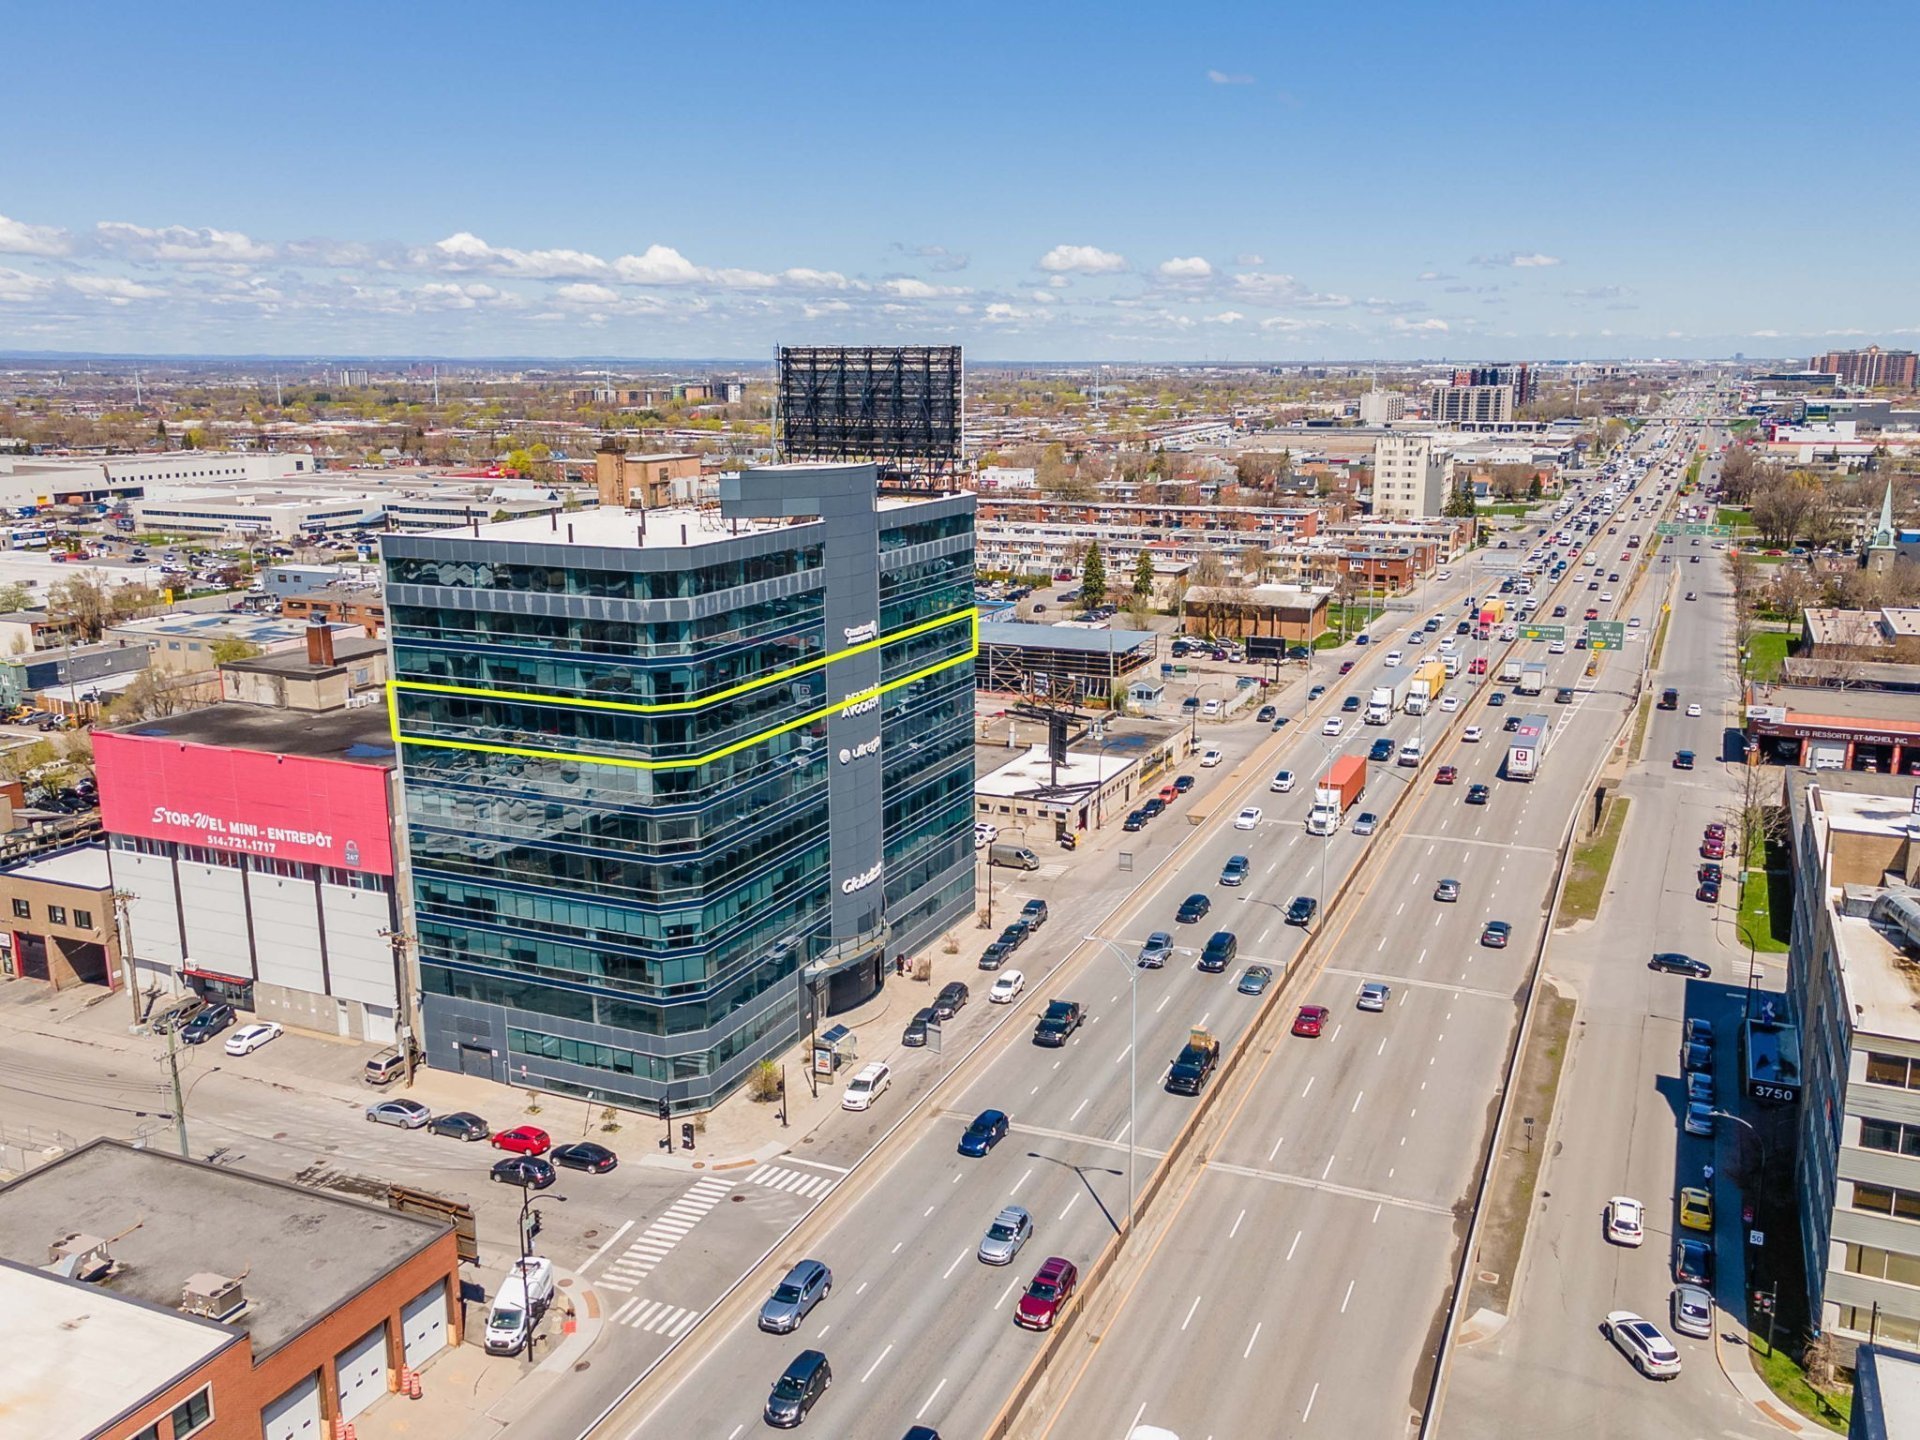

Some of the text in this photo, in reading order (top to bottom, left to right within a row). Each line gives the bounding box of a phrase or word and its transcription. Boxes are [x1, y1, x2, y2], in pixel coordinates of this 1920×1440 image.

[1795, 729, 1810, 737] LES
[1812, 731, 1851, 740] RESSORTS
[229, 821, 258, 837] MINI
[267, 827, 332, 848] ENTREPÔT
[207, 834, 276, 854] 514.721.1717
[1755, 1085, 1793, 1101] 3750
[1752, 1234, 1762, 1243] 50
